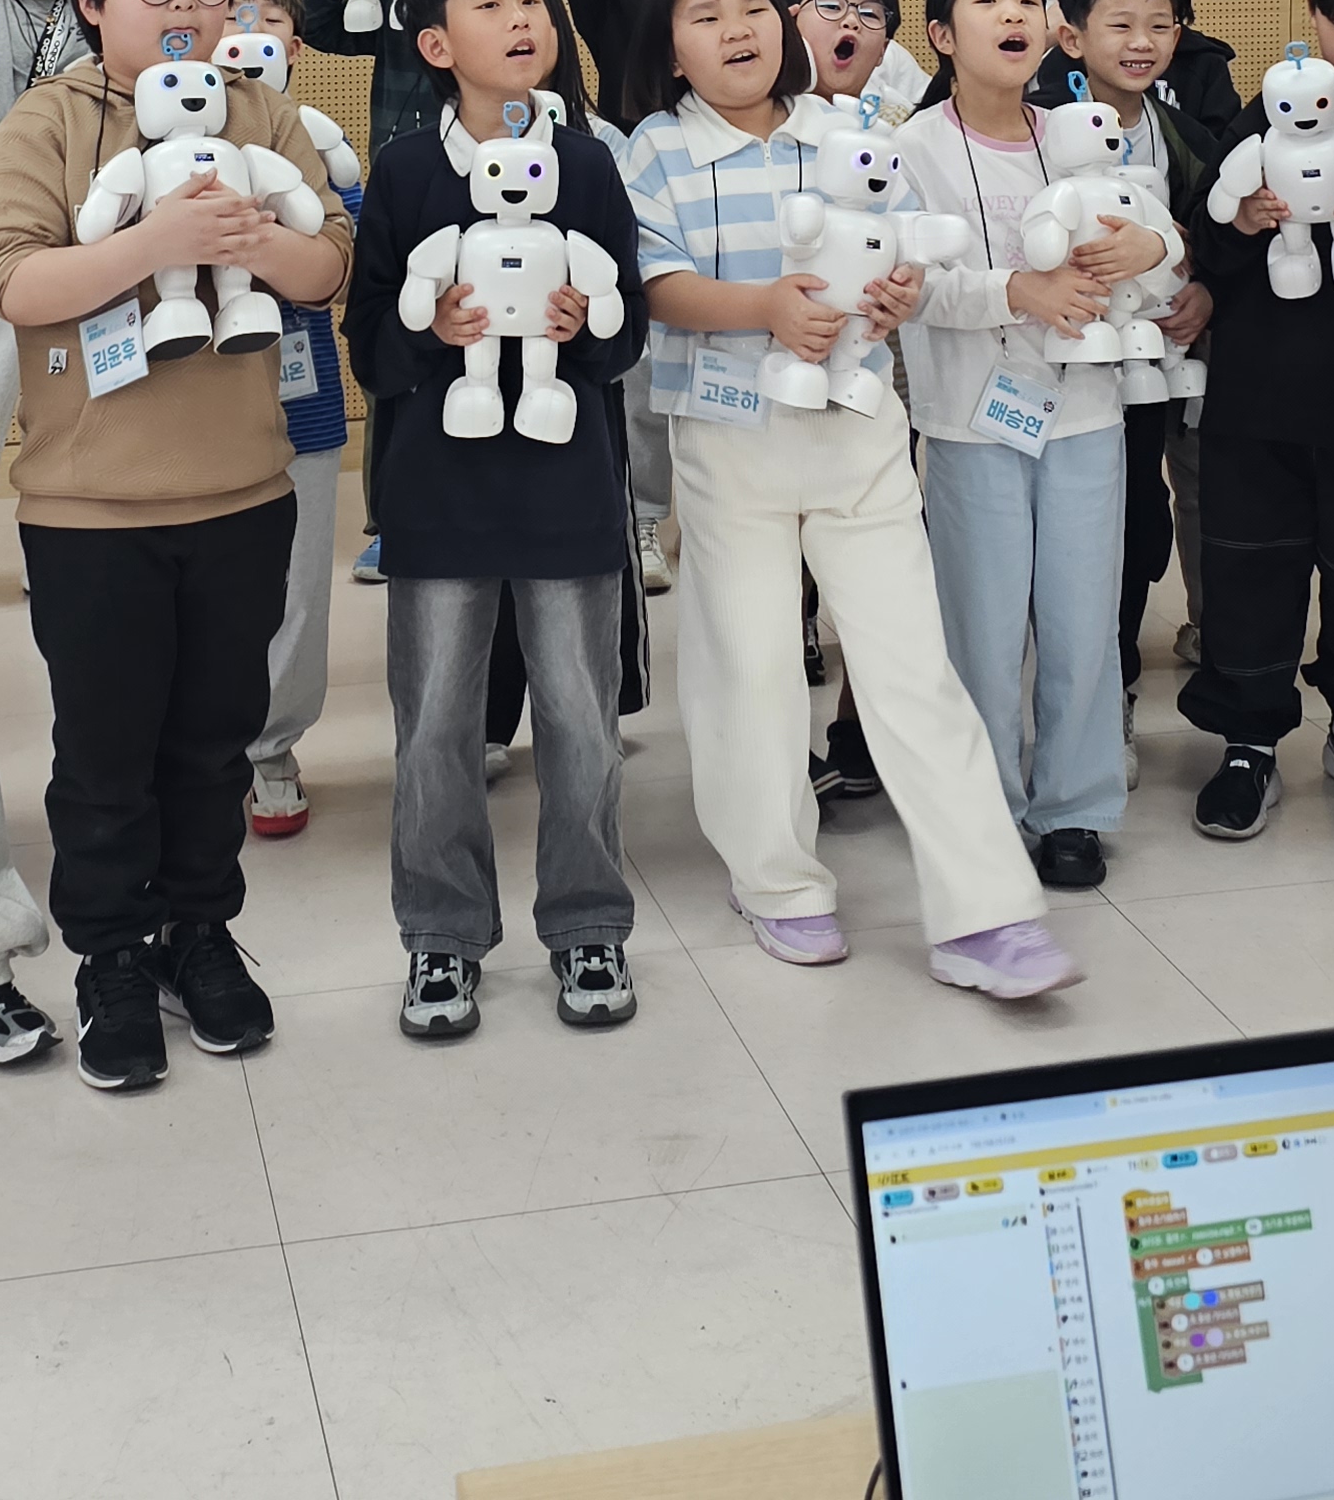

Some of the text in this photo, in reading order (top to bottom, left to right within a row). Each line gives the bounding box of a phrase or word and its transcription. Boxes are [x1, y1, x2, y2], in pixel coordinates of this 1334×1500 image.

[92, 337, 138, 376] 김윤후
[699, 380, 760, 413] 고윤하
[986, 398, 1044, 439] 배승연
